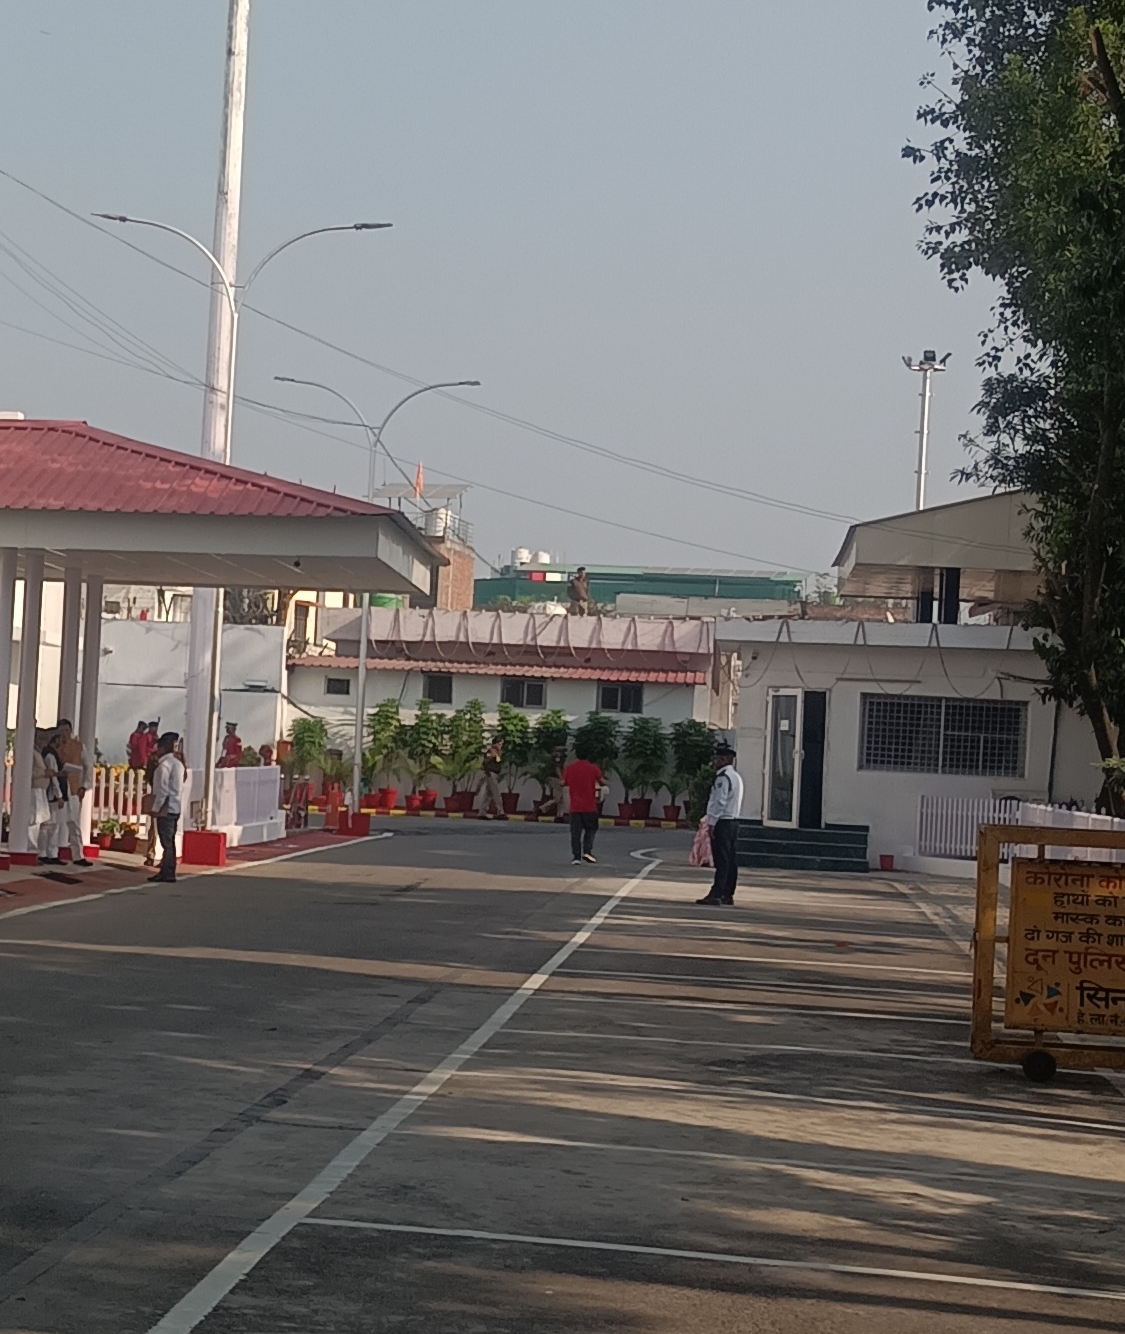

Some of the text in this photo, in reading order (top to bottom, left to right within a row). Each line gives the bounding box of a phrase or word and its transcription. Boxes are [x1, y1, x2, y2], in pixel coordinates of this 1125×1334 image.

[1026, 865, 1125, 890] कोरोना को
[1053, 889, 1119, 908] हाथों को
[1052, 912, 1101, 925] मास्क
[1024, 925, 1041, 941] दो
[1045, 929, 1074, 943] गज
[1078, 927, 1103, 944] की
[1024, 947, 1059, 973] दून
